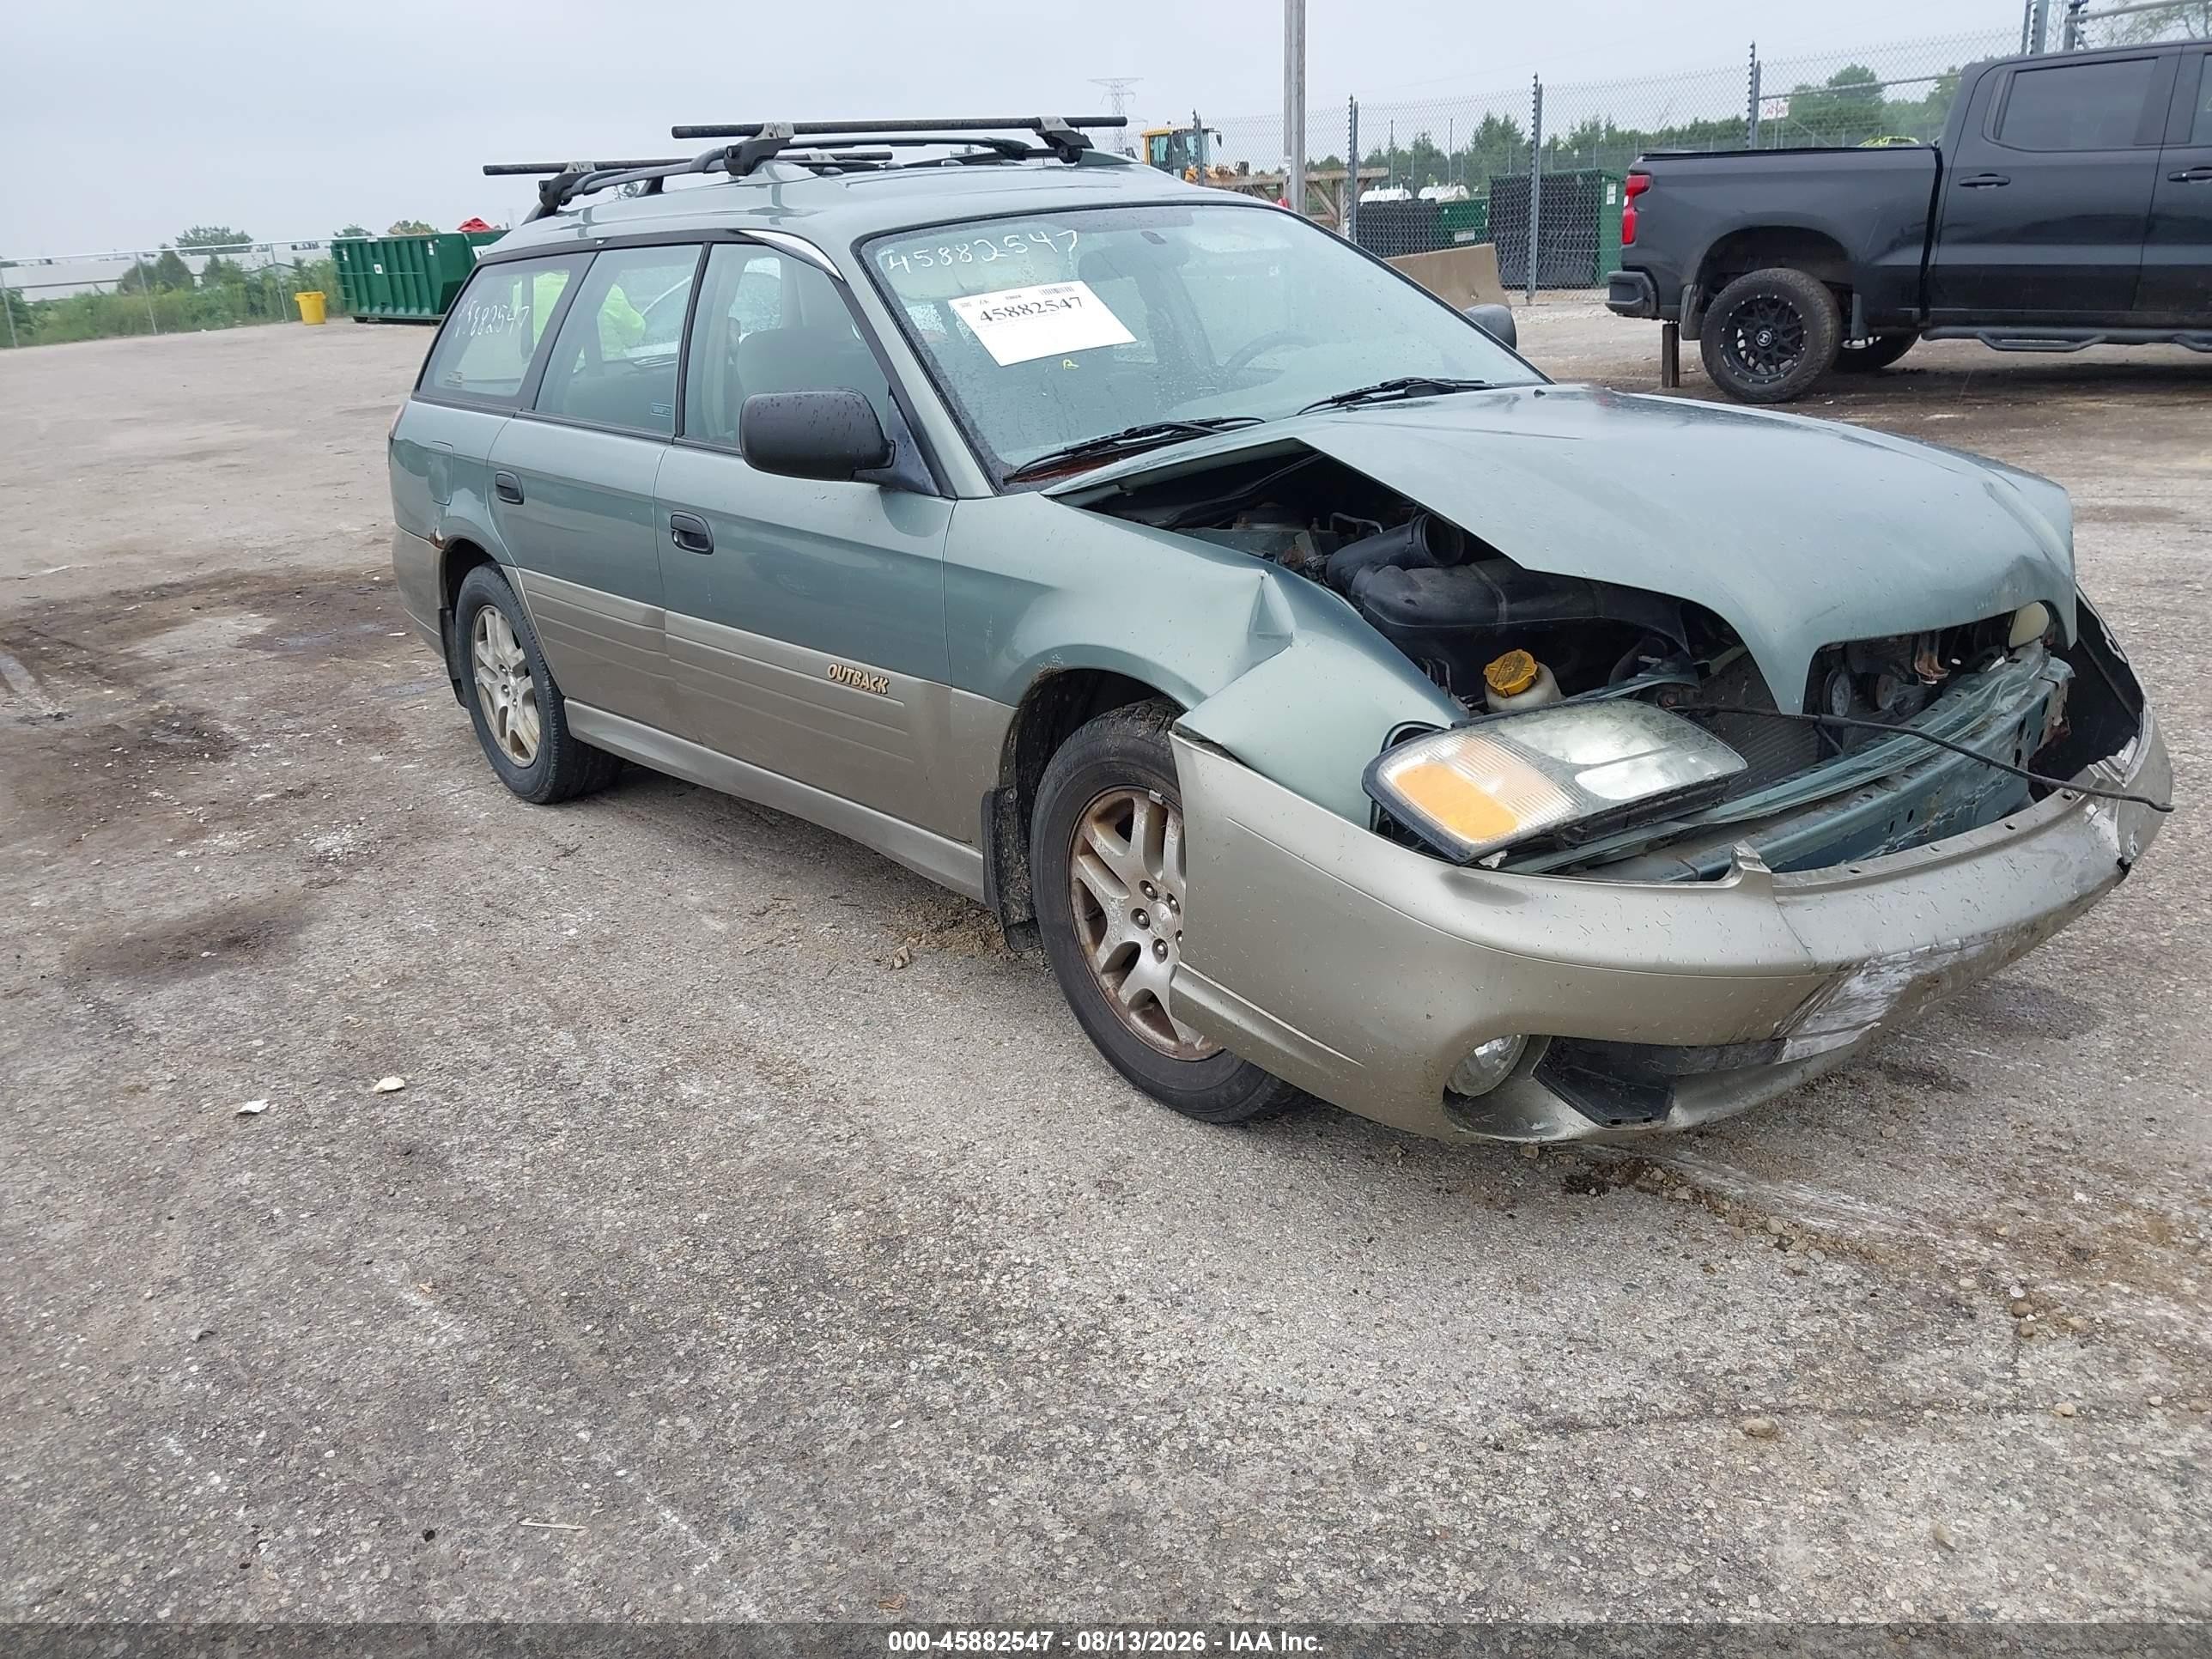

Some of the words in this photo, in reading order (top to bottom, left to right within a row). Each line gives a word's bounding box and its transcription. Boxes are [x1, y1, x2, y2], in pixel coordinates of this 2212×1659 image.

[888, 229, 1079, 274] 45882547
[980, 296, 1084, 322] 45882547
[827, 663, 890, 695] OUTBACK
